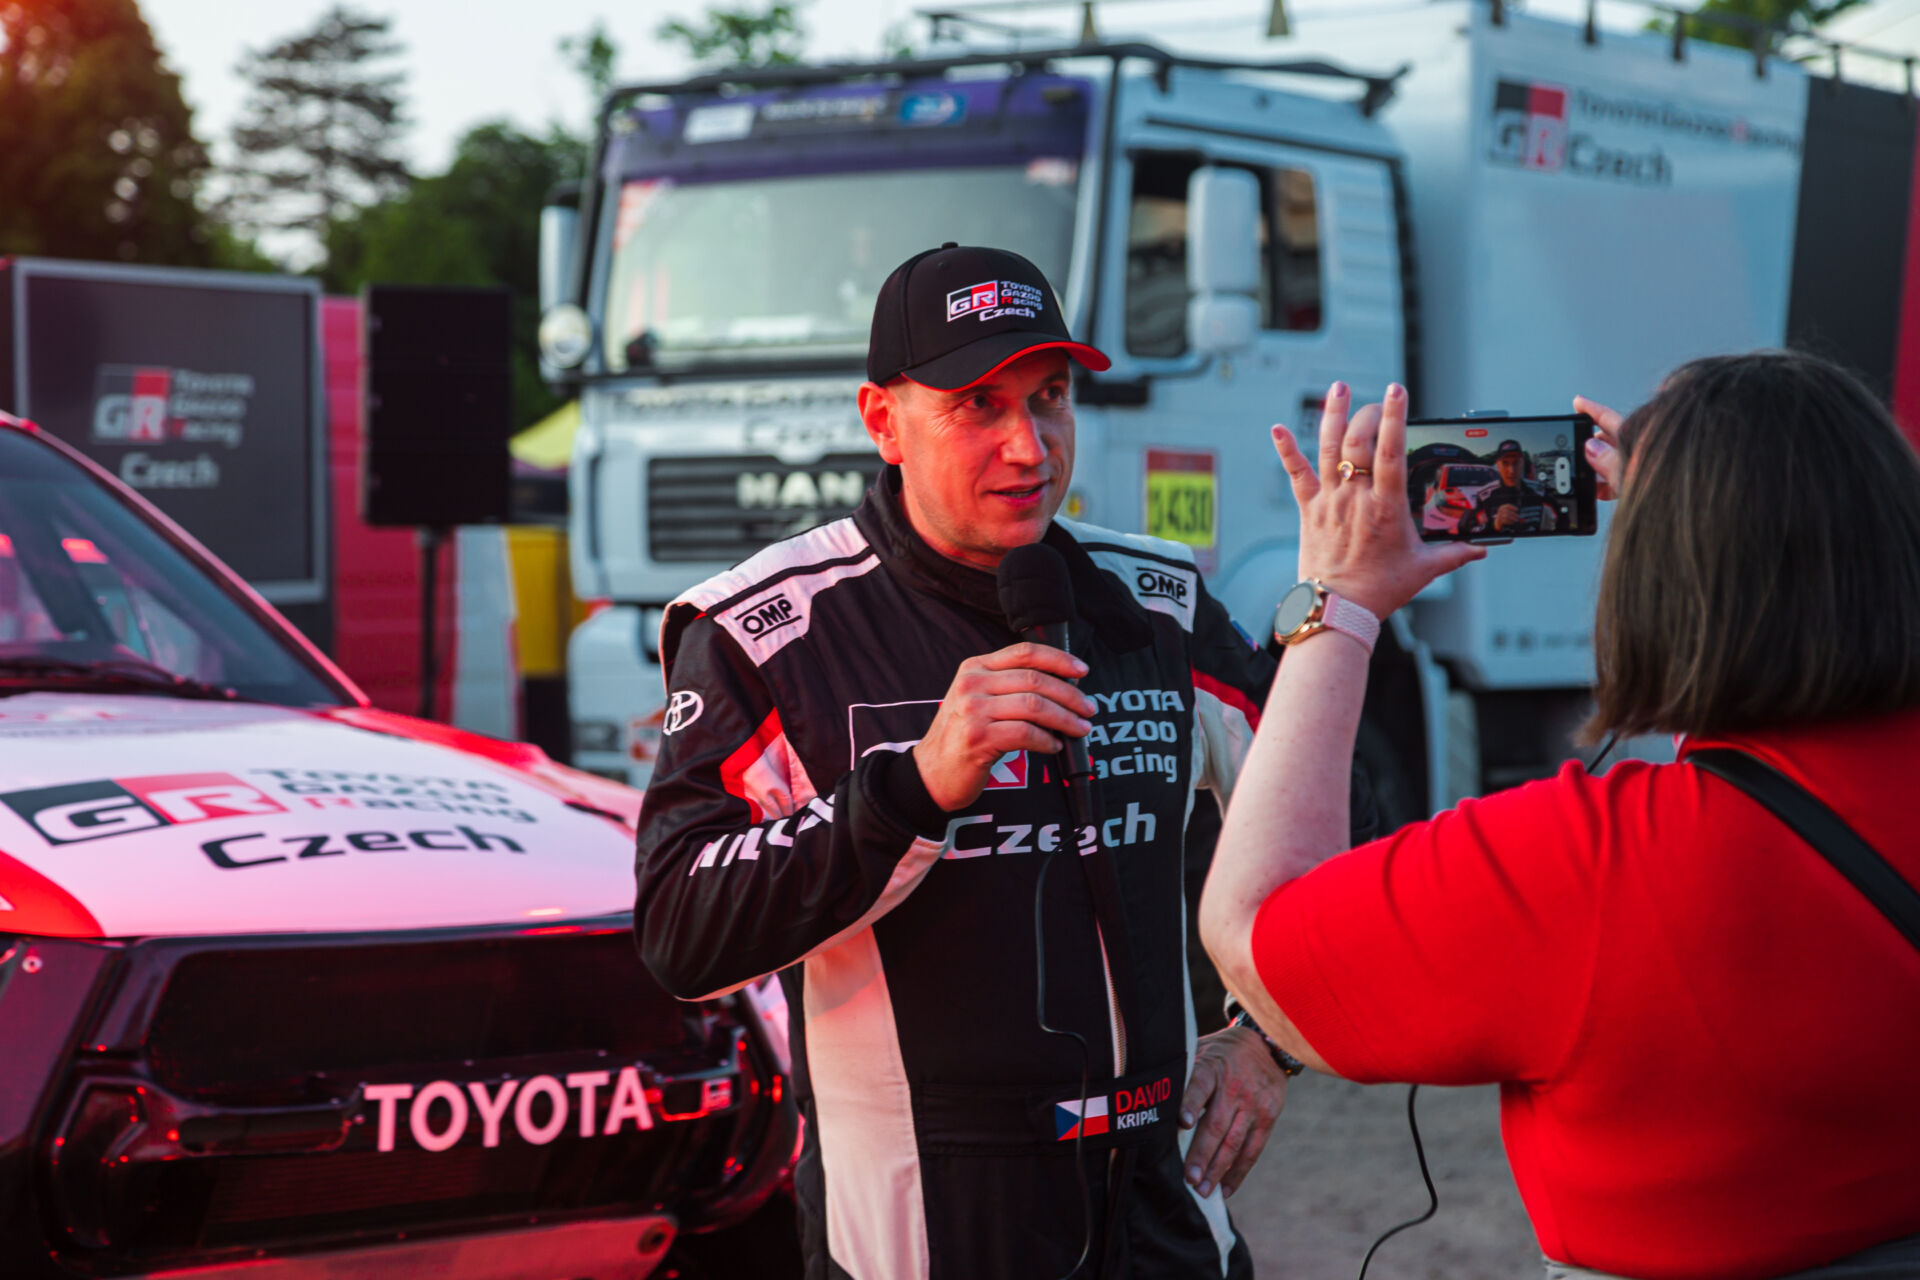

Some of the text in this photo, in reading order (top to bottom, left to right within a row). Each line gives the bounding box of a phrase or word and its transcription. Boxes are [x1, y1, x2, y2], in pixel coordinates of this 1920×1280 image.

[950, 289, 996, 316] GR
[979, 306, 1036, 322] Czech
[1001, 296, 1043, 311] Racing
[119, 451, 220, 489] Czech
[737, 471, 864, 508] MAN
[1137, 572, 1187, 600] OMP
[742, 598, 793, 635] OMP
[1085, 688, 1186, 715] YOTA
[1084, 719, 1178, 747] AZOO
[33, 784, 286, 842] GR
[302, 796, 541, 824] Racing
[200, 823, 528, 871] Czech
[941, 801, 1157, 861] Czech
[363, 1065, 654, 1153] TOYOTA
[1114, 1077, 1172, 1114] DAVID
[1115, 1106, 1161, 1131] KRIPAL
